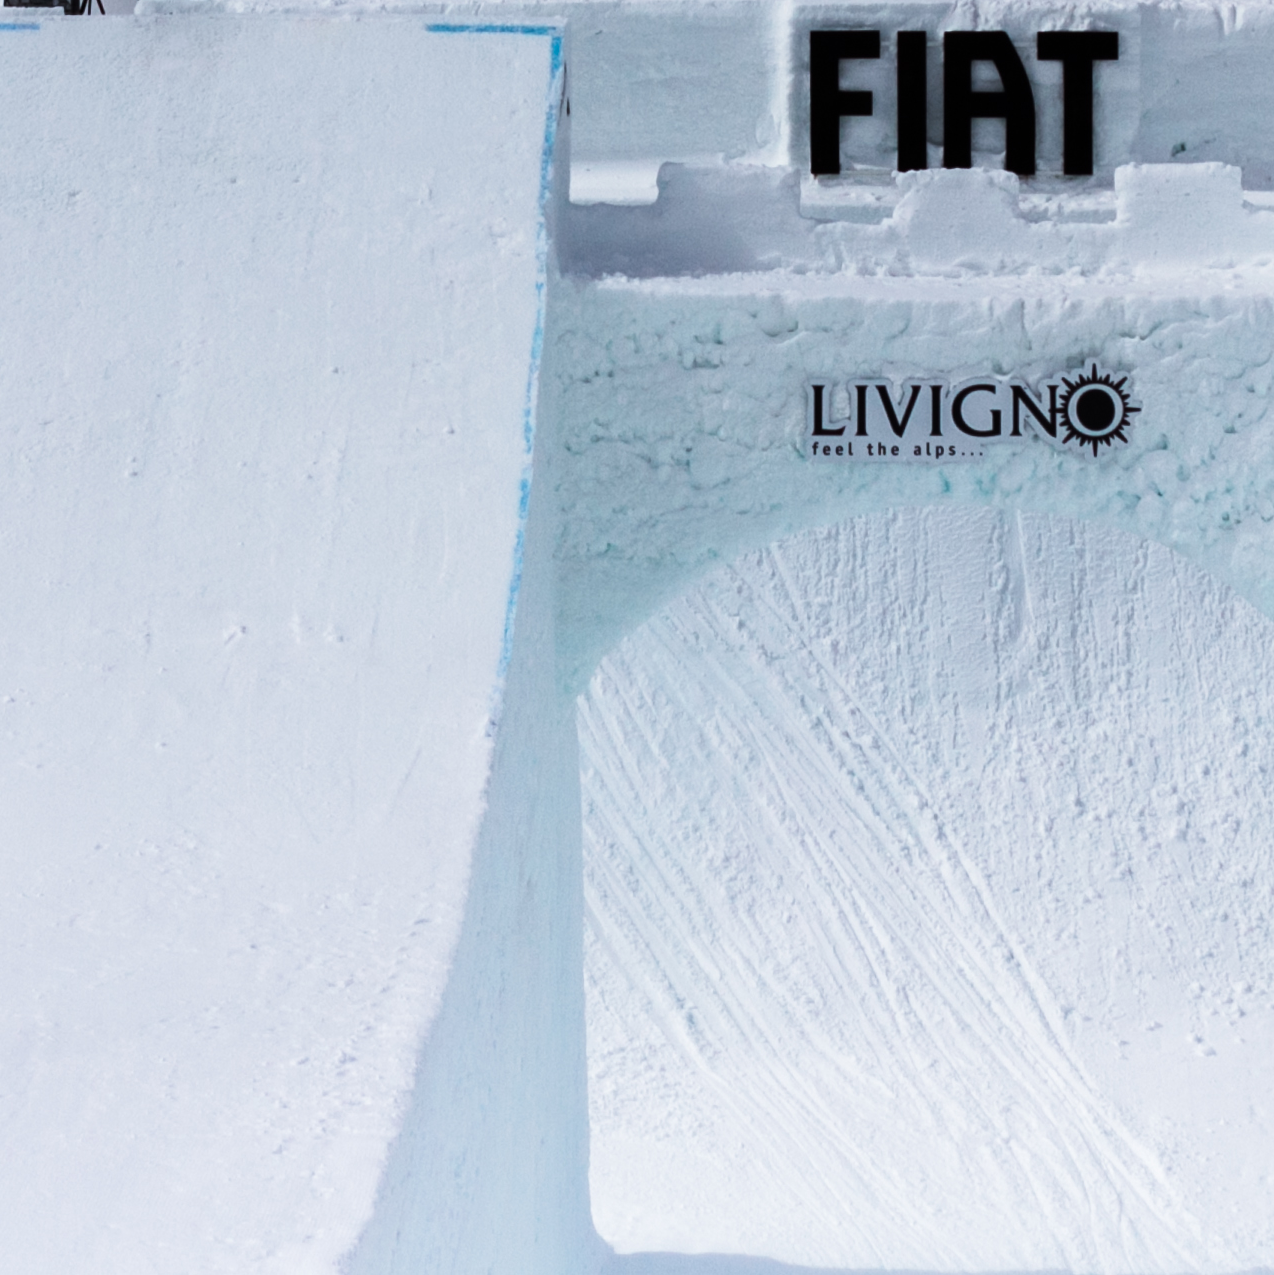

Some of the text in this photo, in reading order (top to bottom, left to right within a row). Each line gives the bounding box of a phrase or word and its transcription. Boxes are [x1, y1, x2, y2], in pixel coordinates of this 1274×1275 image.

[810, 30, 1119, 175] FIAT
[811, 370, 1141, 447] LIVIGNO
[811, 441, 984, 459] feel the alps...
